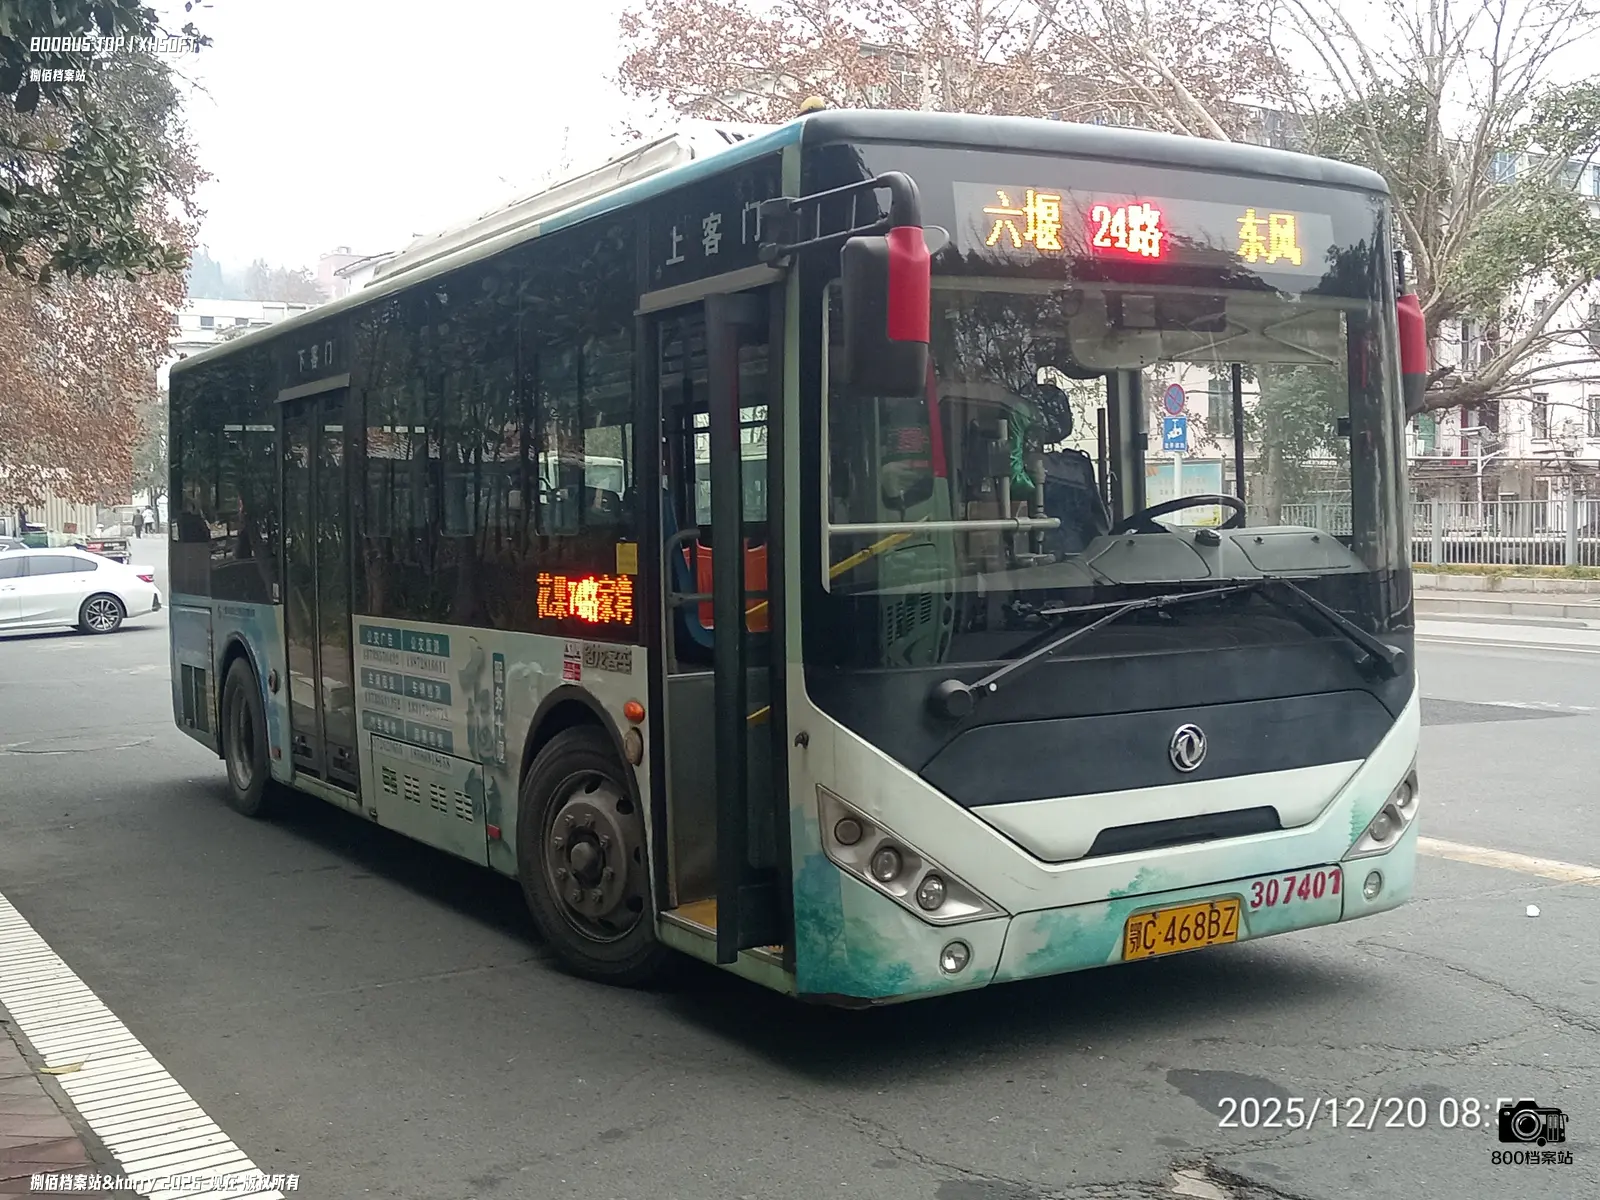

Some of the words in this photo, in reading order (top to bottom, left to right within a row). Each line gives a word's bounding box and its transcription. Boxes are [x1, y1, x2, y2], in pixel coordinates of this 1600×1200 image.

[665, 200, 761, 266] 上客门
[982, 189, 1064, 251] 六堰
[1091, 202, 1163, 258] 24路
[1250, 868, 1343, 909] 307401
